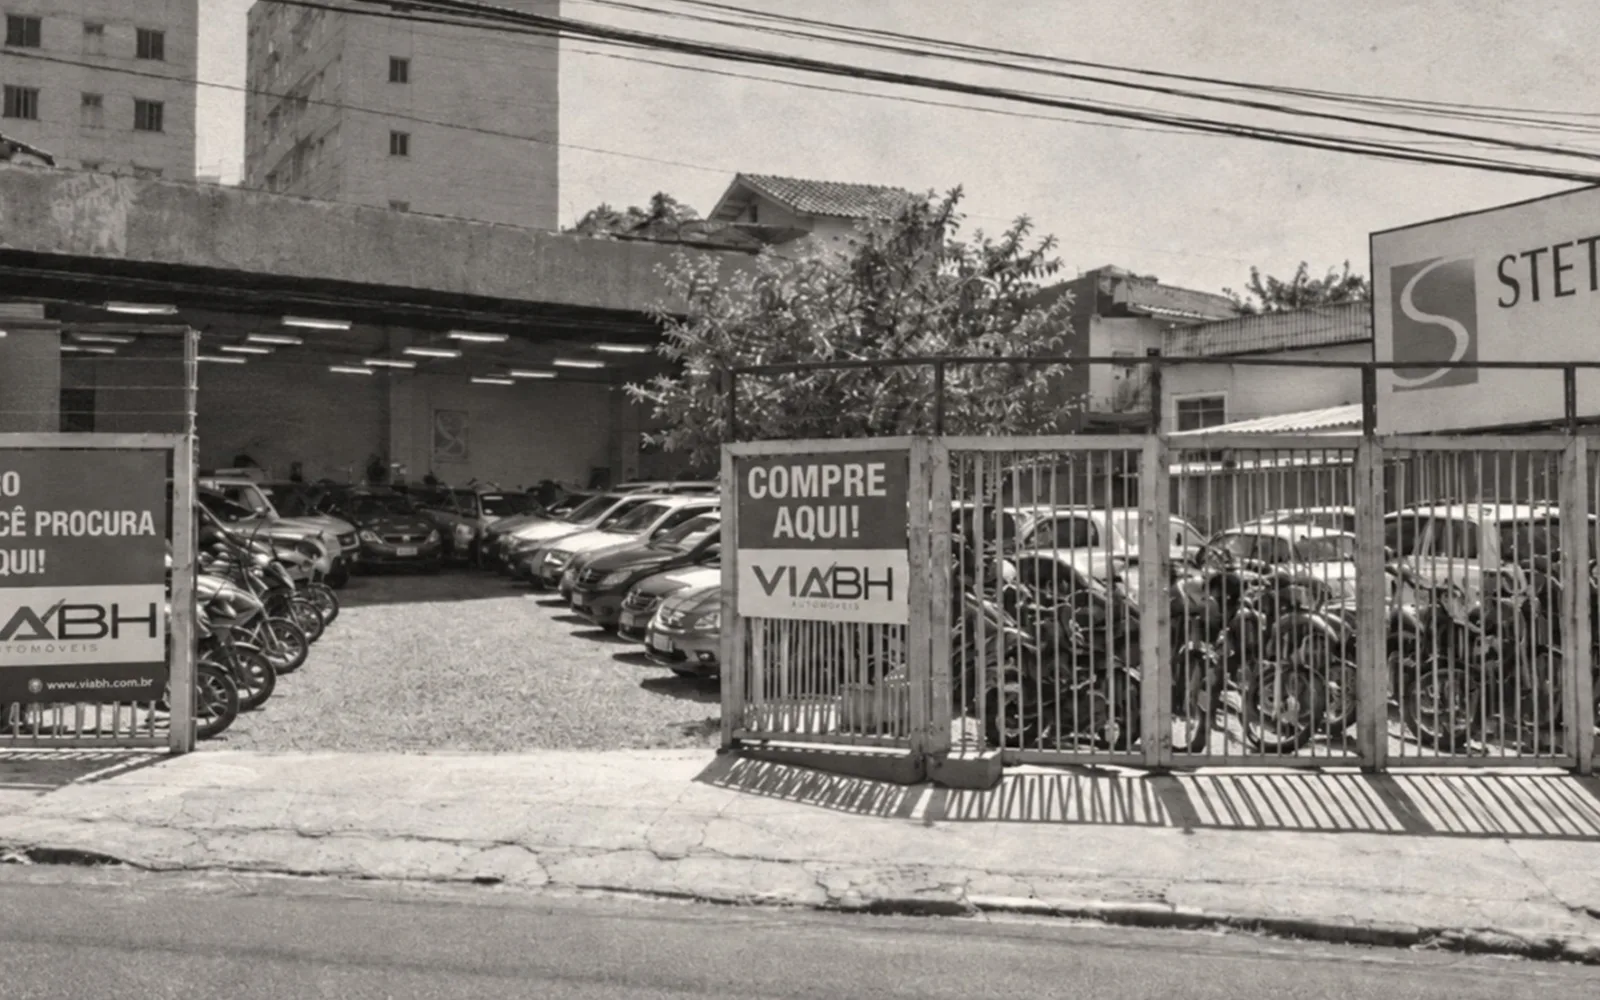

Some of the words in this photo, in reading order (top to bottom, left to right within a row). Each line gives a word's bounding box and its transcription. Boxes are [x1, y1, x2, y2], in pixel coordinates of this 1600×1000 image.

[1497, 234, 1600, 308] STET
[0, 470, 20, 497] O
[748, 462, 887, 499] COMPRE
[35, 510, 156, 537] PROCURA
[773, 505, 860, 542] AQUI!
[0, 643, 99, 654] TOMÓVEIS
[47, 677, 154, 690] www.viabh.com.br
